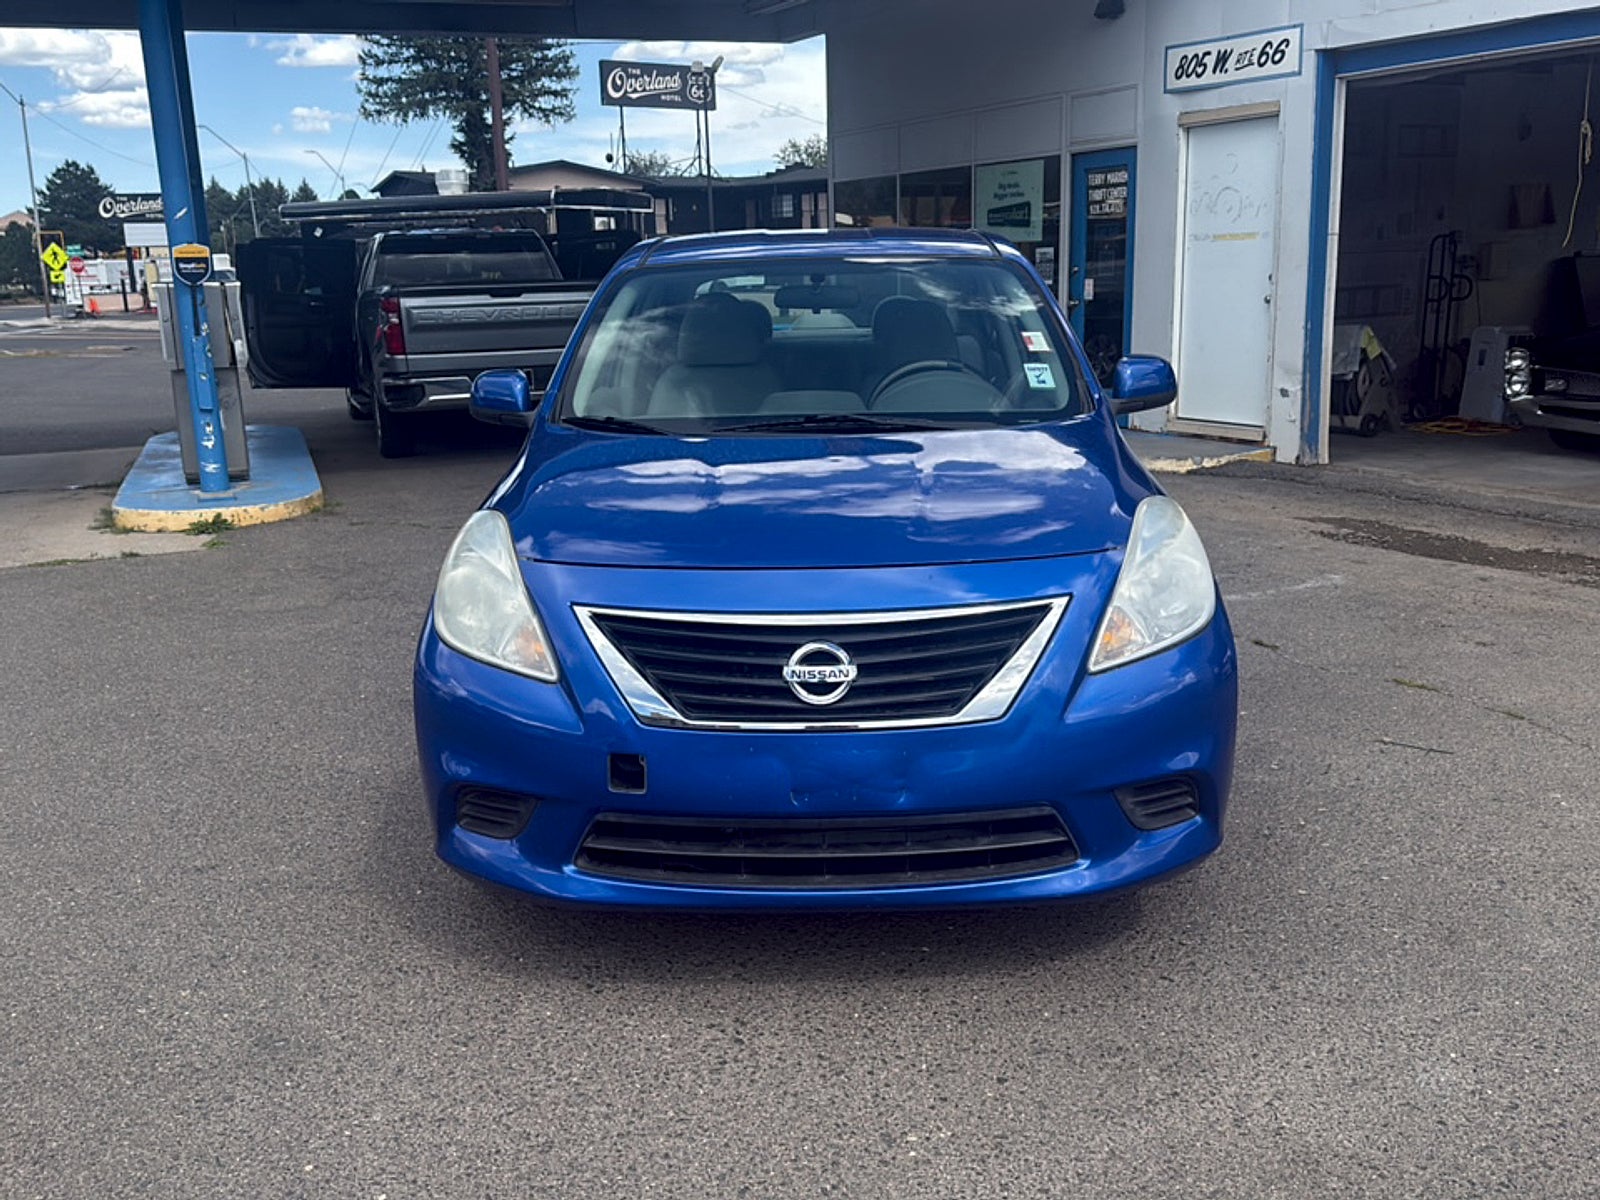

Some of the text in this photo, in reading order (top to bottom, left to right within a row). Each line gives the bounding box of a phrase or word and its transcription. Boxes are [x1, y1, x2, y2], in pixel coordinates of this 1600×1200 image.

[1174, 51, 1212, 80] 805
[1212, 48, 1234, 75] W.
[1257, 38, 1290, 68] 66
[607, 67, 682, 99] Overland
[99, 196, 164, 218] Overland
[790, 669, 850, 680] NISSAN
